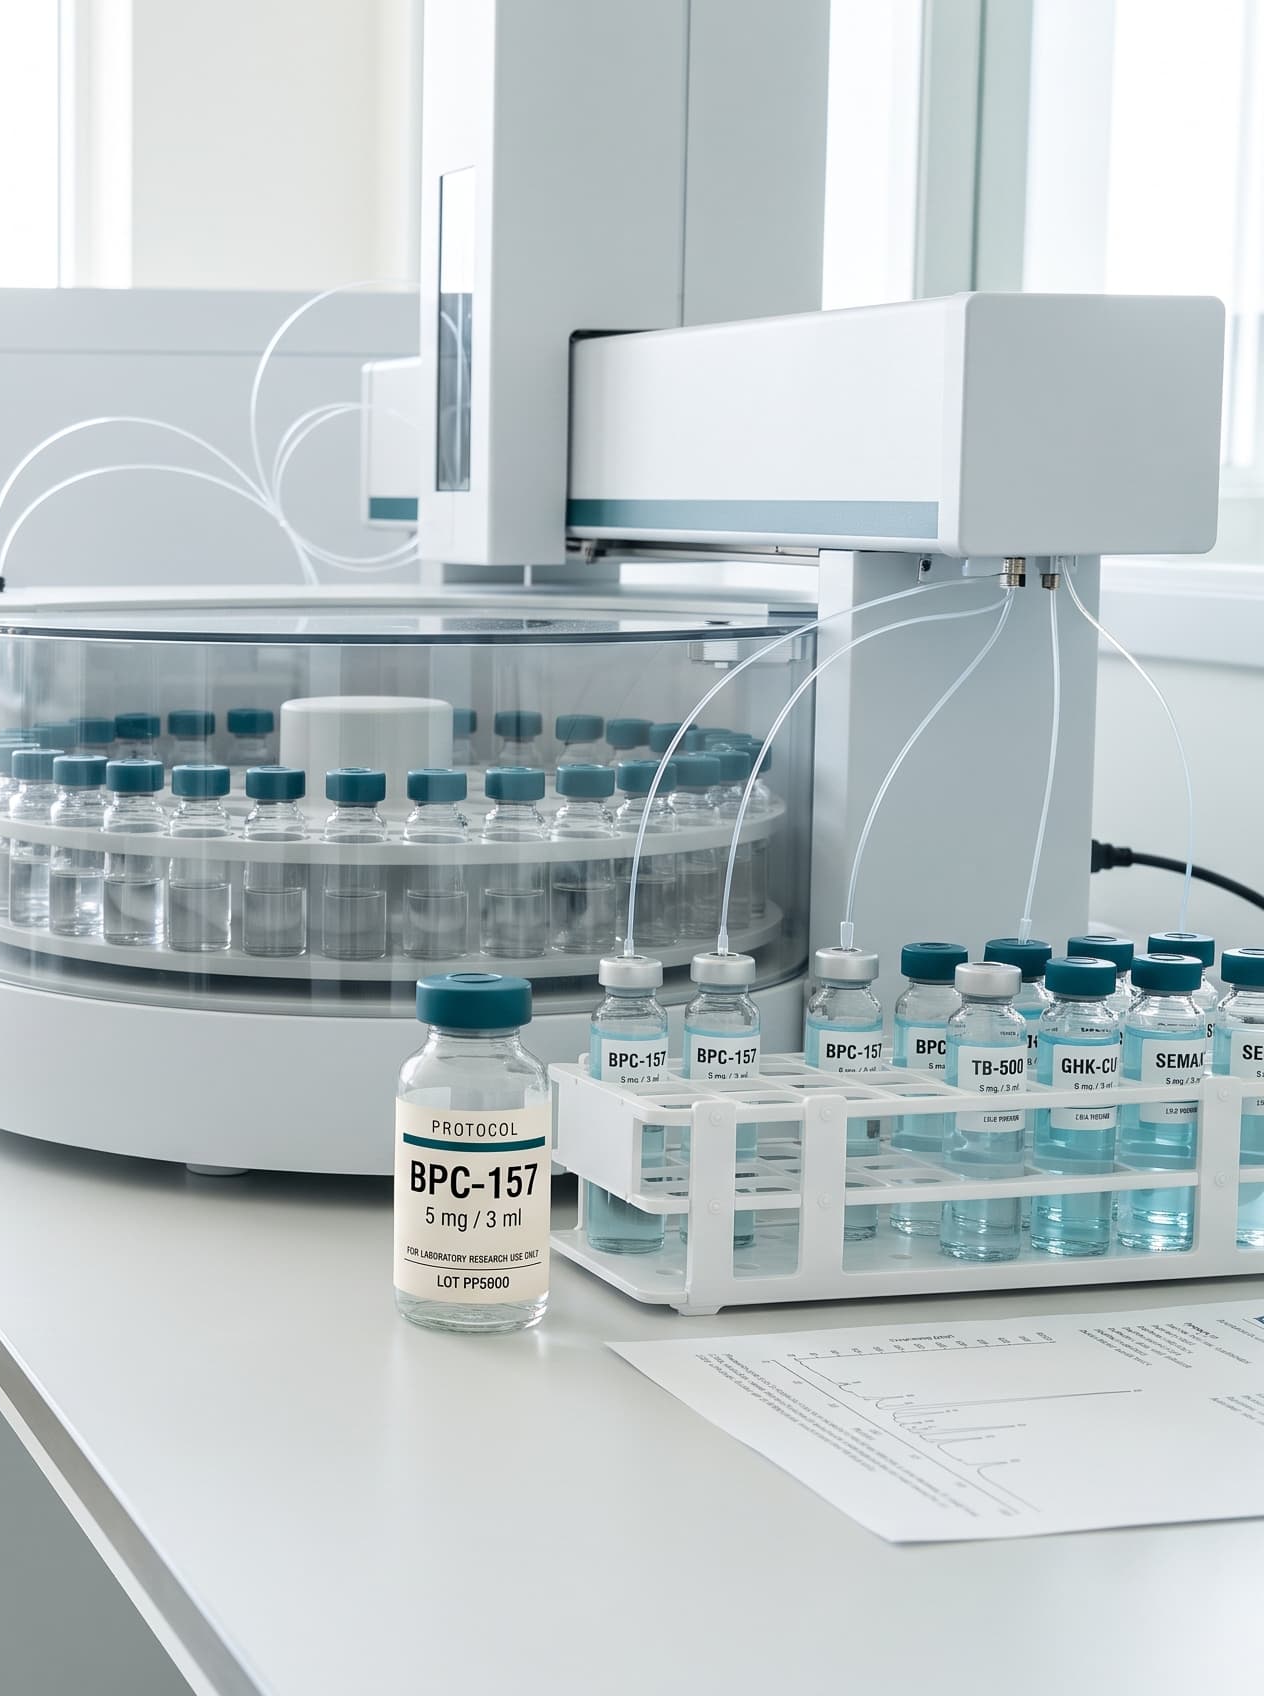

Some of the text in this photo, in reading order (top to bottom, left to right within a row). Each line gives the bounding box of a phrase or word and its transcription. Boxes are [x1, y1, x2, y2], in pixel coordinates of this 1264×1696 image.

[609, 1051, 666, 1068] BPC-157
[698, 1048, 756, 1064] BPC-157
[826, 1043, 882, 1059] BPC-157
[972, 1058, 1024, 1075] TB-500
[1062, 1057, 1118, 1074] GHK-CU
[432, 1120, 518, 1137] PROTOCOL
[411, 1160, 538, 1199] BPC-157
[425, 1207, 522, 1232] 5 mg / 3 ml
[407, 1246, 419, 1256] FOR
[420, 1250, 466, 1263] LABORATORY
[469, 1254, 508, 1264] RESEARCH
[510, 1252, 523, 1262] USE
[437, 1275, 460, 1289] LOT
